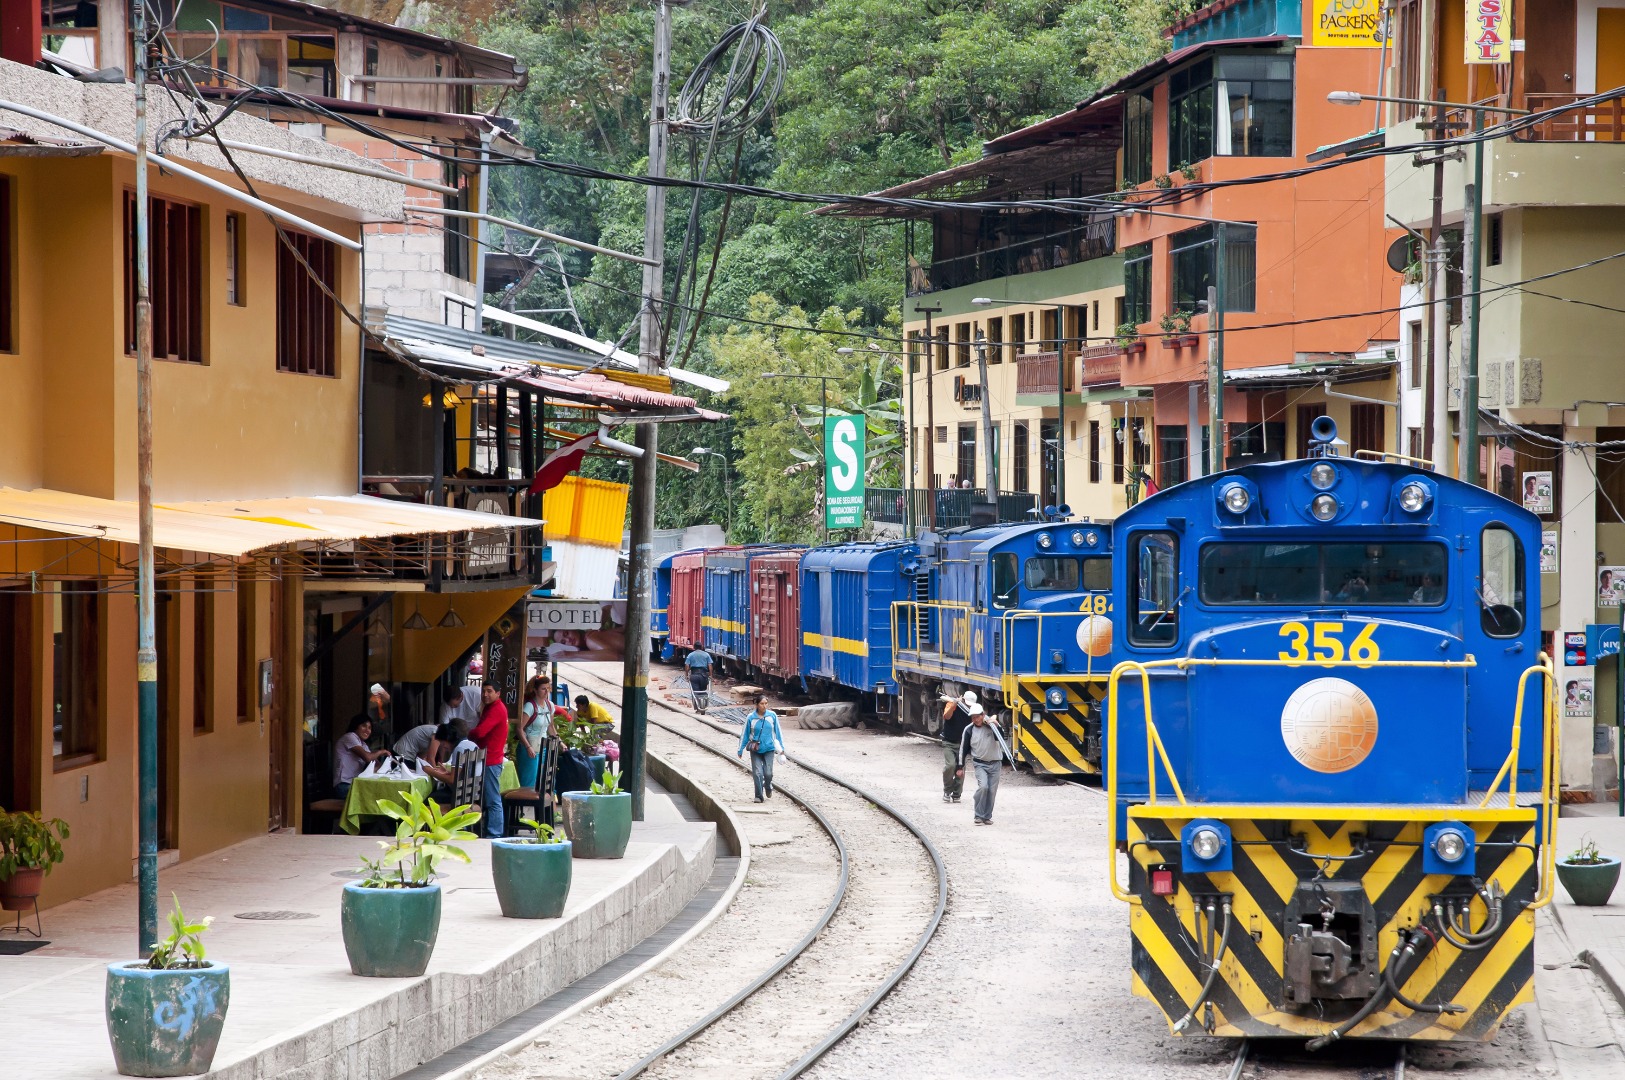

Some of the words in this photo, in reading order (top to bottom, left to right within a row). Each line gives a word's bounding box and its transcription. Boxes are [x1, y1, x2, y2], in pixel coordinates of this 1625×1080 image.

[1320, 14, 1376, 30] PACKERS
[831, 418, 858, 492] S
[529, 609, 602, 624] HOTEL
[1278, 621, 1380, 669] 356
[506, 656, 518, 704] INN
